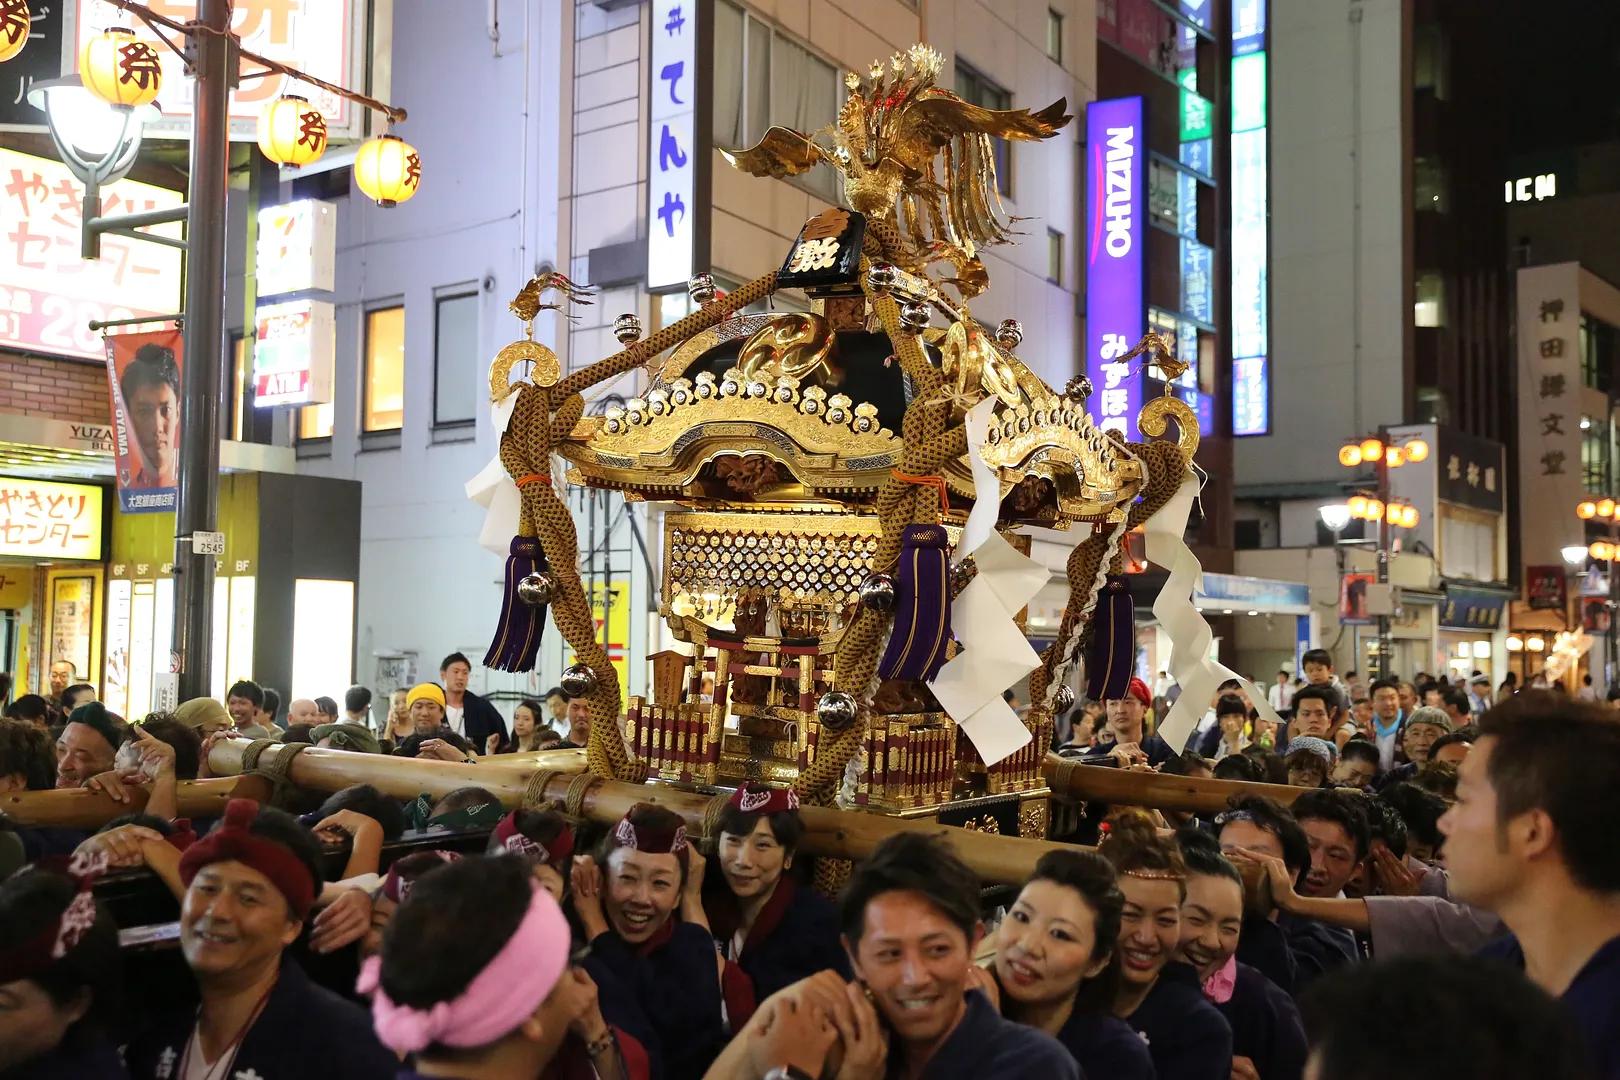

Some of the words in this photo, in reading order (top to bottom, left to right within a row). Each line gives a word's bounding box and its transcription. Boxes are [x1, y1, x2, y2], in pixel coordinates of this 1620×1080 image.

[118, 42, 162, 90] 祭
[299, 111, 328, 152] 祭
[5, 168, 156, 232] やき
[1105, 125, 1134, 258] MIZUHO
[115, 409, 129, 457] OYAMA
[0, 488, 87, 521] やきとり
[0, 518, 90, 548] センター
[200, 543, 224, 554] 2545
[113, 564, 126, 576] 6F
[136, 563, 149, 575] 5F
[160, 562, 173, 574] 4F
